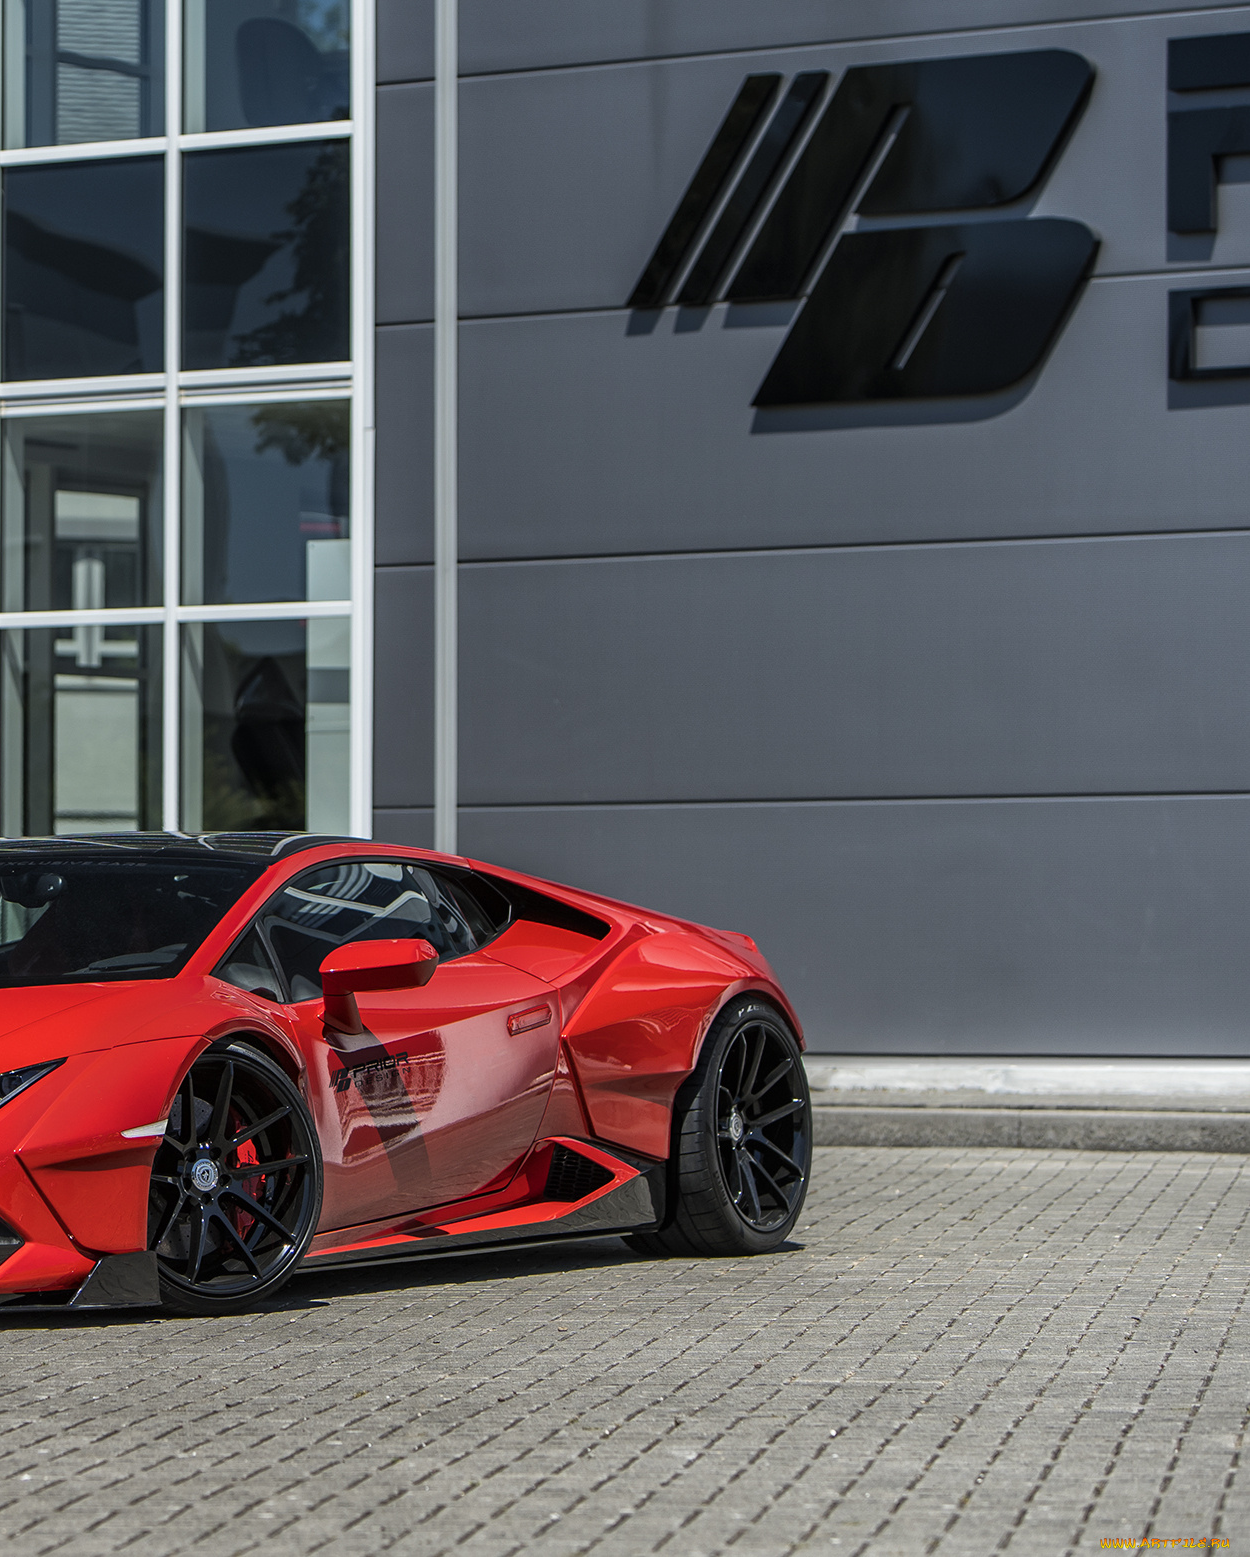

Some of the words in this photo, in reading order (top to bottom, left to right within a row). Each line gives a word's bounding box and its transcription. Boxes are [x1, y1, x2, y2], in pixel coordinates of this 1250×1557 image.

[97, 861, 148, 869] CARS
[353, 1052, 409, 1078] PRIOR
[354, 1066, 411, 1087] DESIGN
